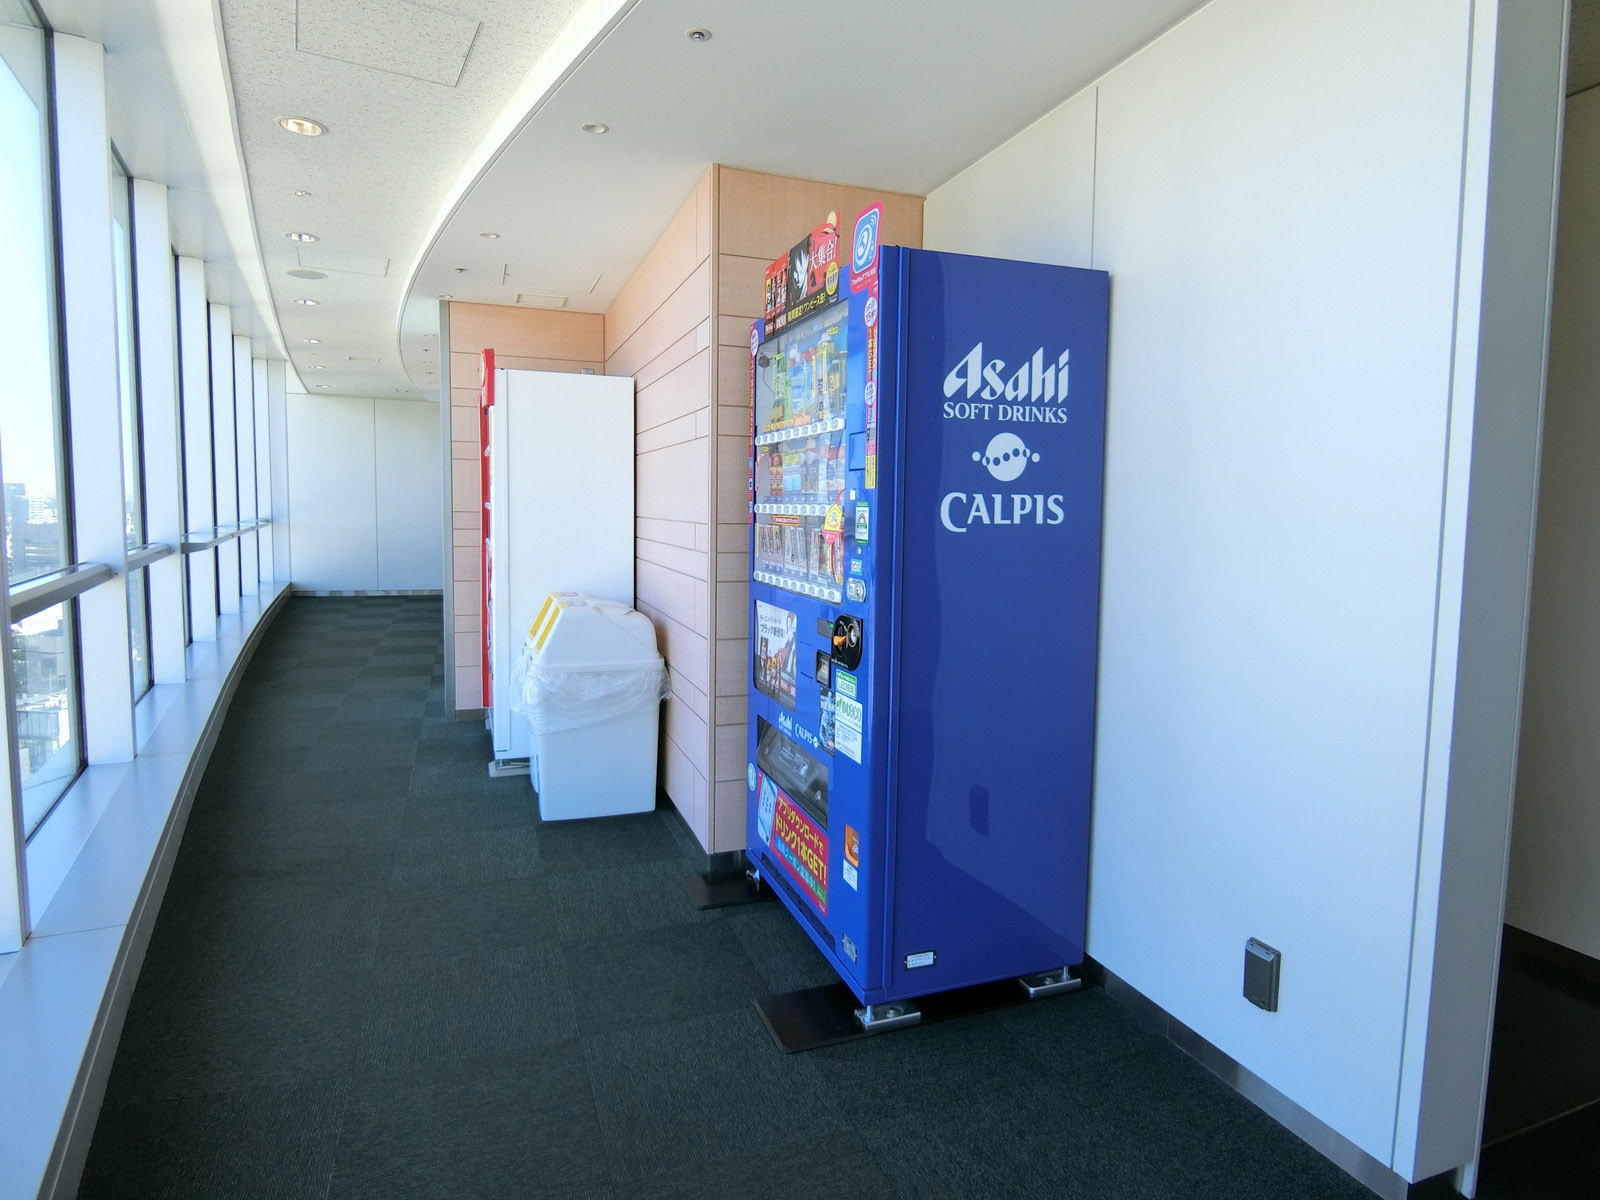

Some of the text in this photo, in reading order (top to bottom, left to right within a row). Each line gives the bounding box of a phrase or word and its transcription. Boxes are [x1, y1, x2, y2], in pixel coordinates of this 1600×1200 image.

[809, 235, 838, 272] 大集合!
[943, 342, 1069, 404] Asahi
[943, 402, 1068, 424] SOFT DRINKS
[940, 492, 1065, 533] CALPIS
[775, 812, 827, 885] ドリンク1本GET!
[778, 796, 824, 855] アプリダウンロードで
